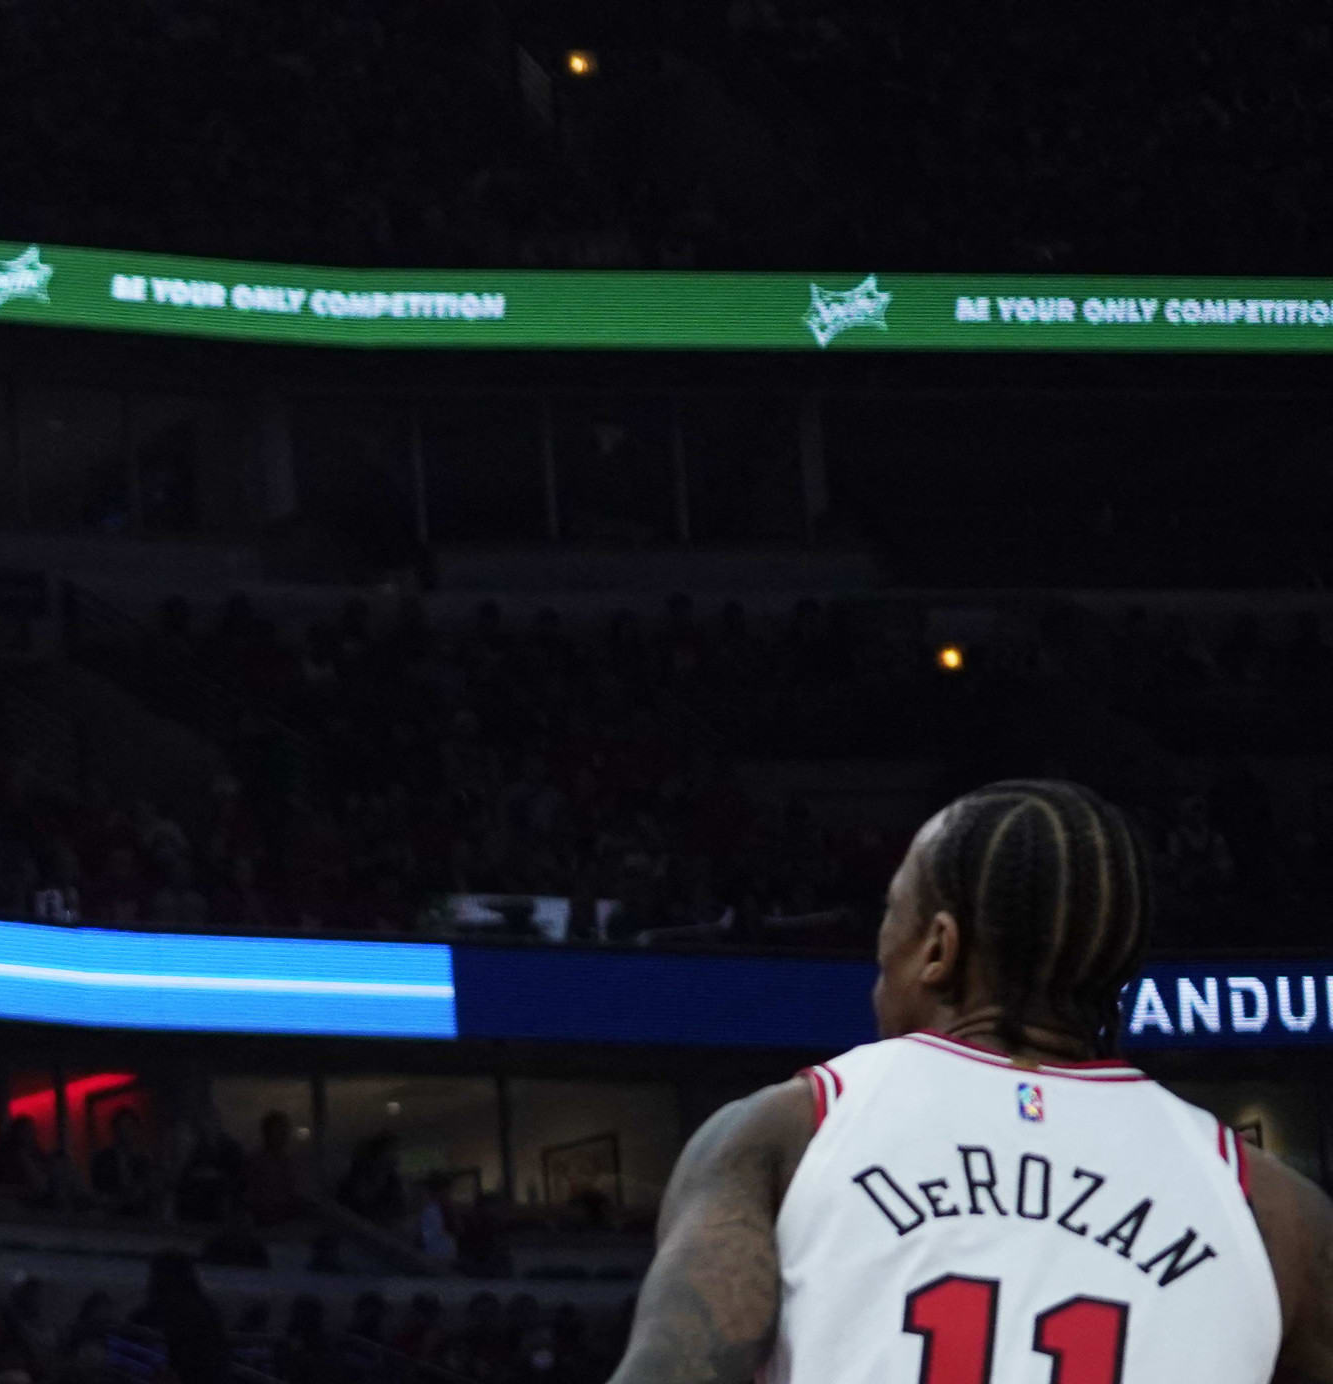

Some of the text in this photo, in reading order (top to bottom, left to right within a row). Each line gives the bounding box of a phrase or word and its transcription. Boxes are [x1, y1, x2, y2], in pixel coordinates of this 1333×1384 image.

[150, 277, 228, 309] YOUR
[309, 288, 506, 320] COMPETITION
[955, 295, 1333, 327] BE YOUR ONLY COMPETITIO
[1118, 974, 1333, 1036] ANDU
[853, 1145, 1216, 1288] DeROZAN
